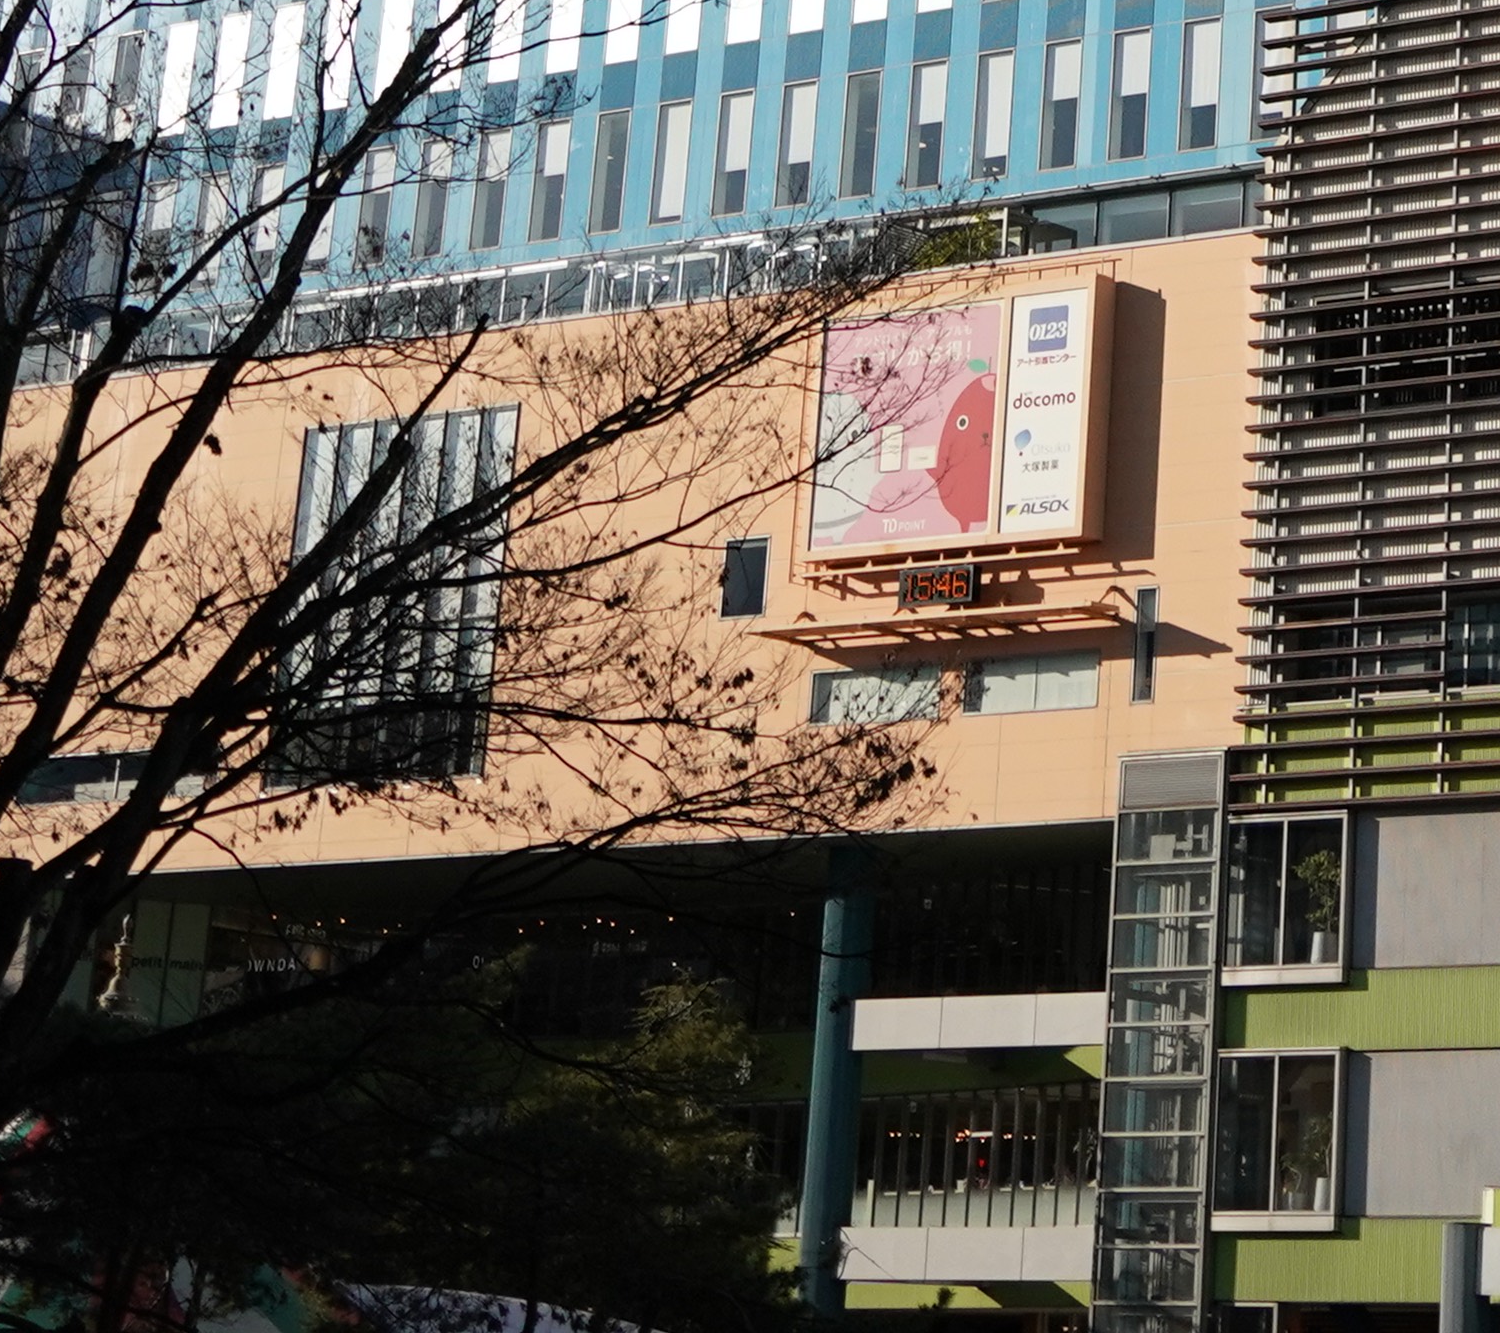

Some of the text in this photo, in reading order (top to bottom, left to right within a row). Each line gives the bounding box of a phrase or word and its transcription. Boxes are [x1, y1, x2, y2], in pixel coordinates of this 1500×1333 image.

[1029, 320, 1068, 342] 0123
[1013, 392, 1076, 410] docomo
[1030, 441, 1071, 457] Otsuka
[1019, 499, 1070, 516] ALSOK
[898, 519, 926, 533] POINT
[904, 569, 968, 603] 15:46
